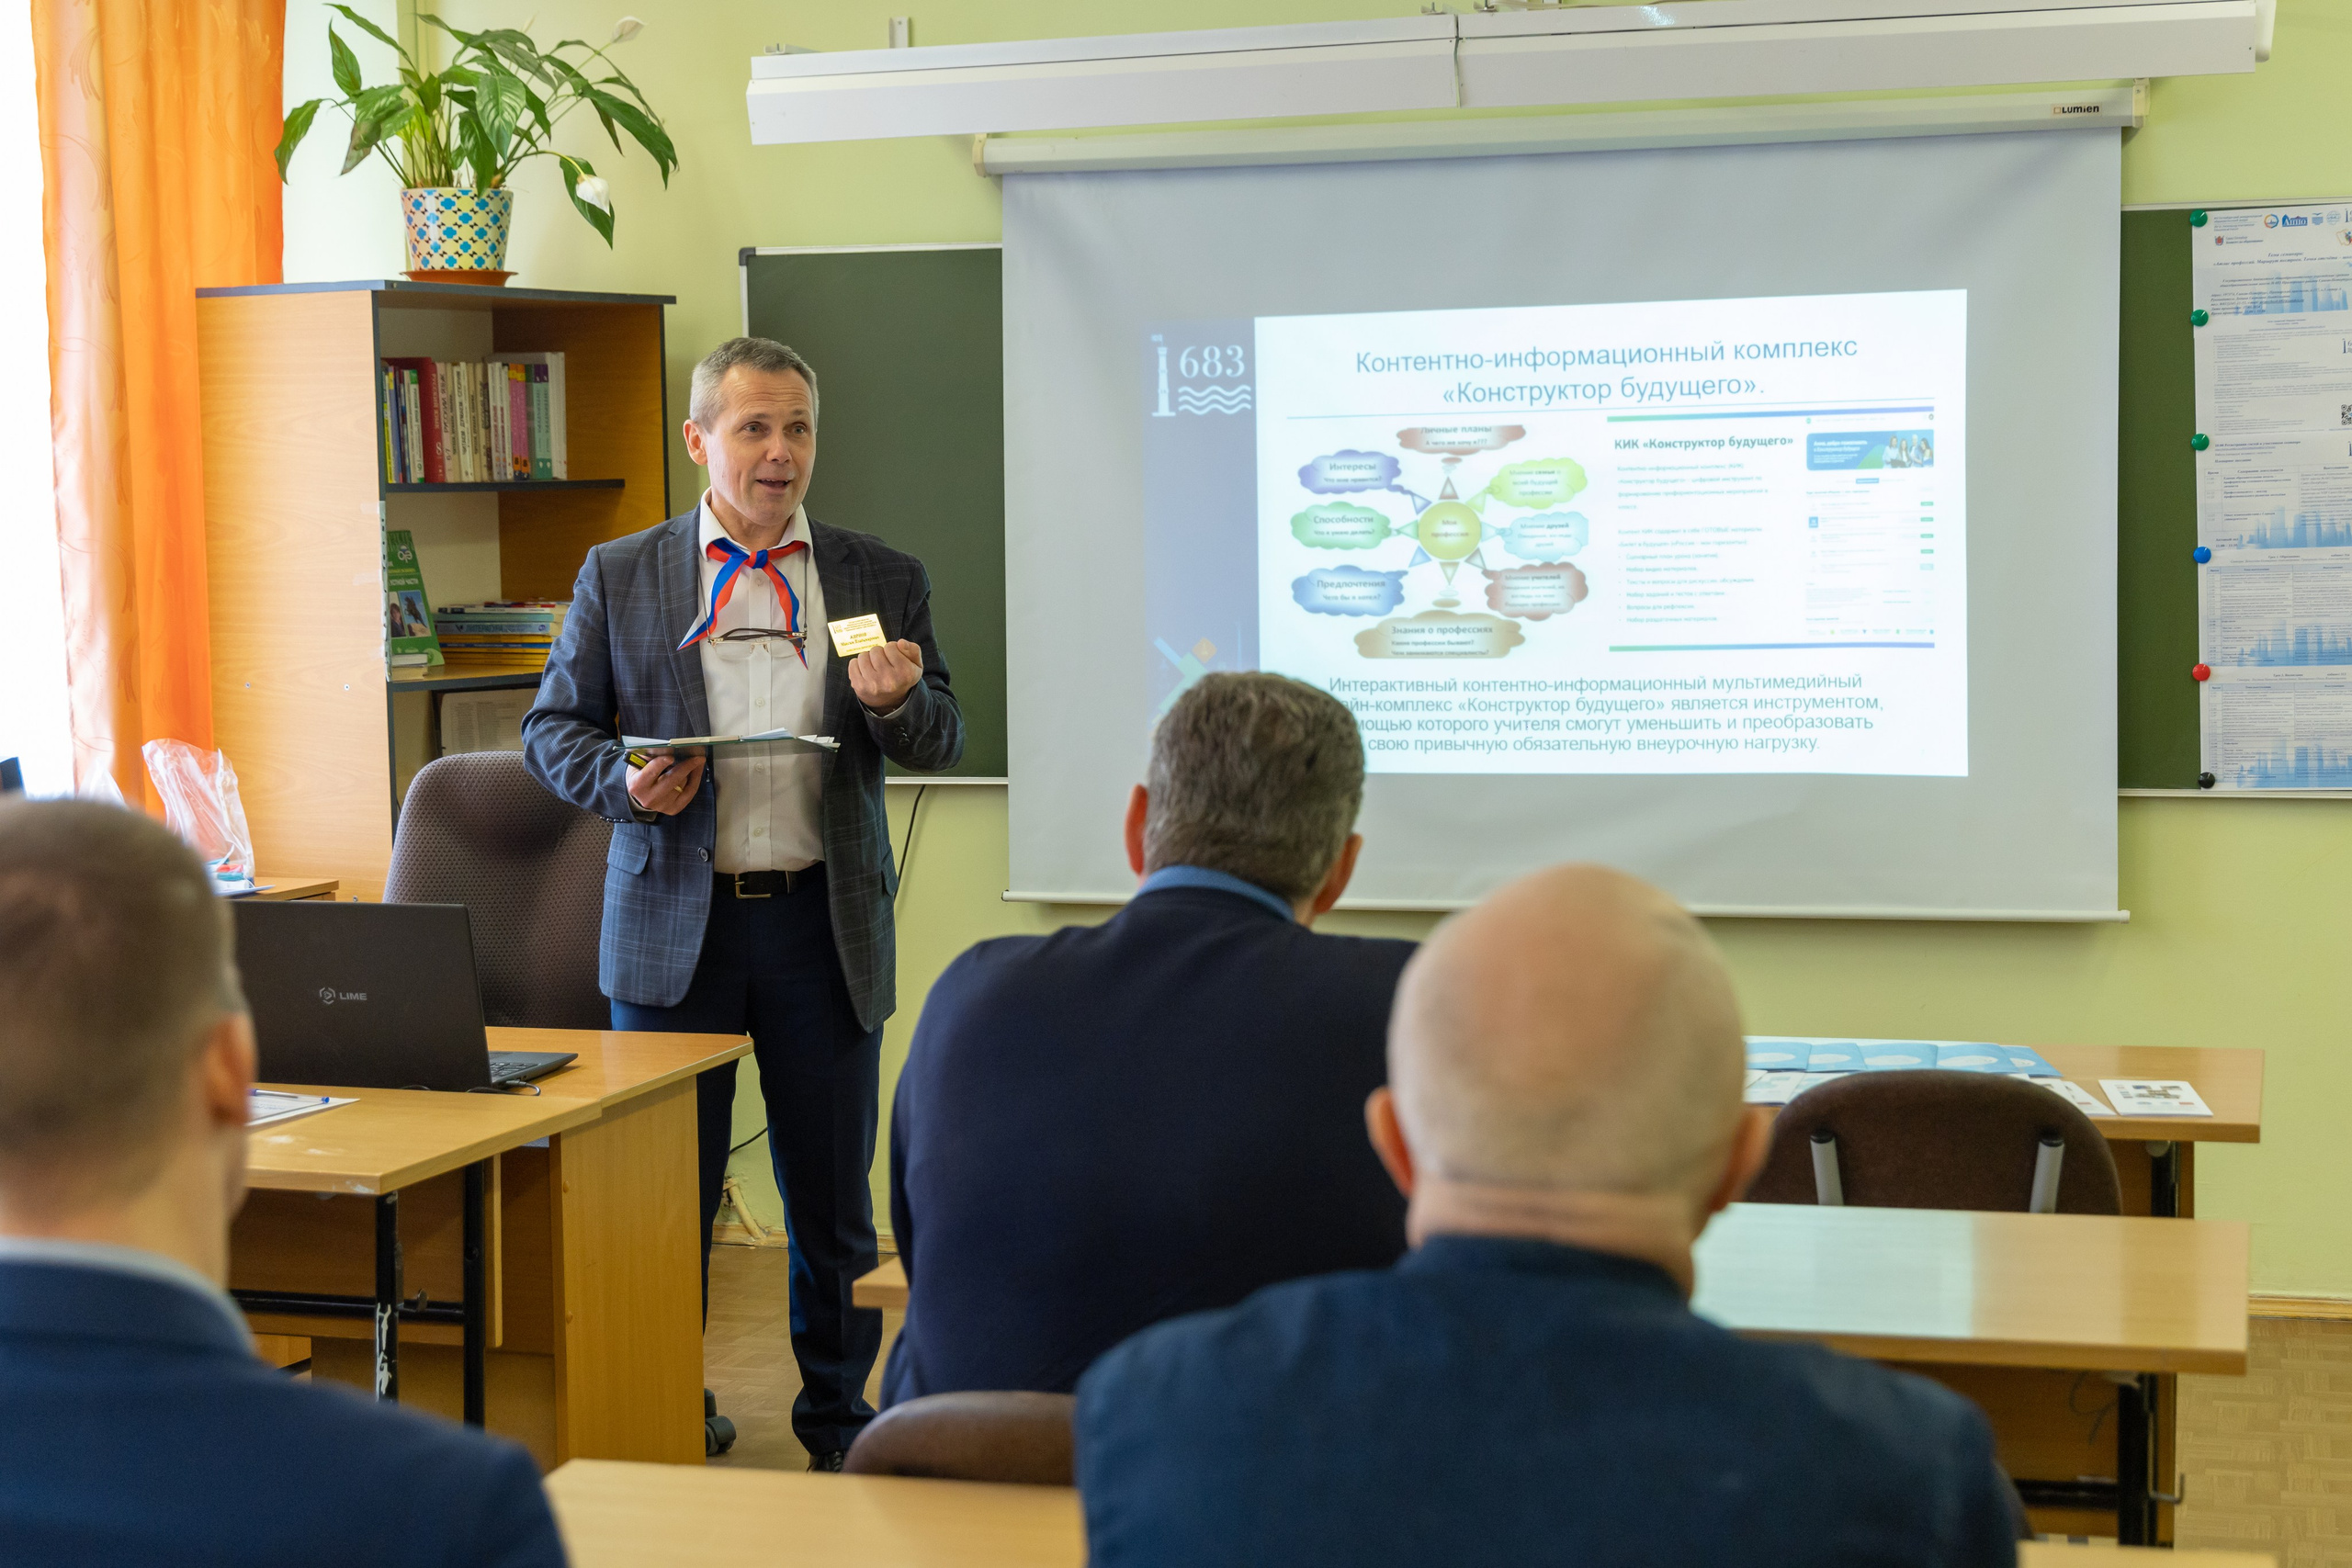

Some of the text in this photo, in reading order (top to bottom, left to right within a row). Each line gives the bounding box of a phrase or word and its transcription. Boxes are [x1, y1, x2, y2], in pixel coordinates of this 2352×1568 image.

[1179, 344, 1246, 379] 683
[1355, 340, 1858, 373] Контентно-информационный комплекс
[1442, 376, 1765, 407] «Конструктор будущего».
[1614, 435, 1793, 451] КИК «Конструктор будущего»
[1329, 462, 1376, 471] Интересы
[1313, 514, 1374, 524] Способности
[1316, 580, 1386, 589] Предпочтения
[1391, 626, 1426, 635] Знания
[1436, 626, 1493, 635] профессиях
[1329, 673, 1862, 695] Интерактивный контентно-информационный мультимедийный
[1458, 698, 1571, 716] «Конструктор
[1576, 696, 1665, 716] будущего»
[1670, 697, 1748, 711] является
[1753, 695, 1884, 713] инструментом,
[1417, 719, 1489, 734] которого
[1494, 718, 1560, 735] учителя
[1566, 718, 1622, 735] смогут
[1626, 718, 1722, 734] уменьшить
[1726, 717, 1737, 730] и
[1742, 714, 1874, 733] преобразовать
[1367, 736, 1821, 754] свою привычную обязательную внеурочную нагрузку.
[339, 992, 368, 1001] LIME
